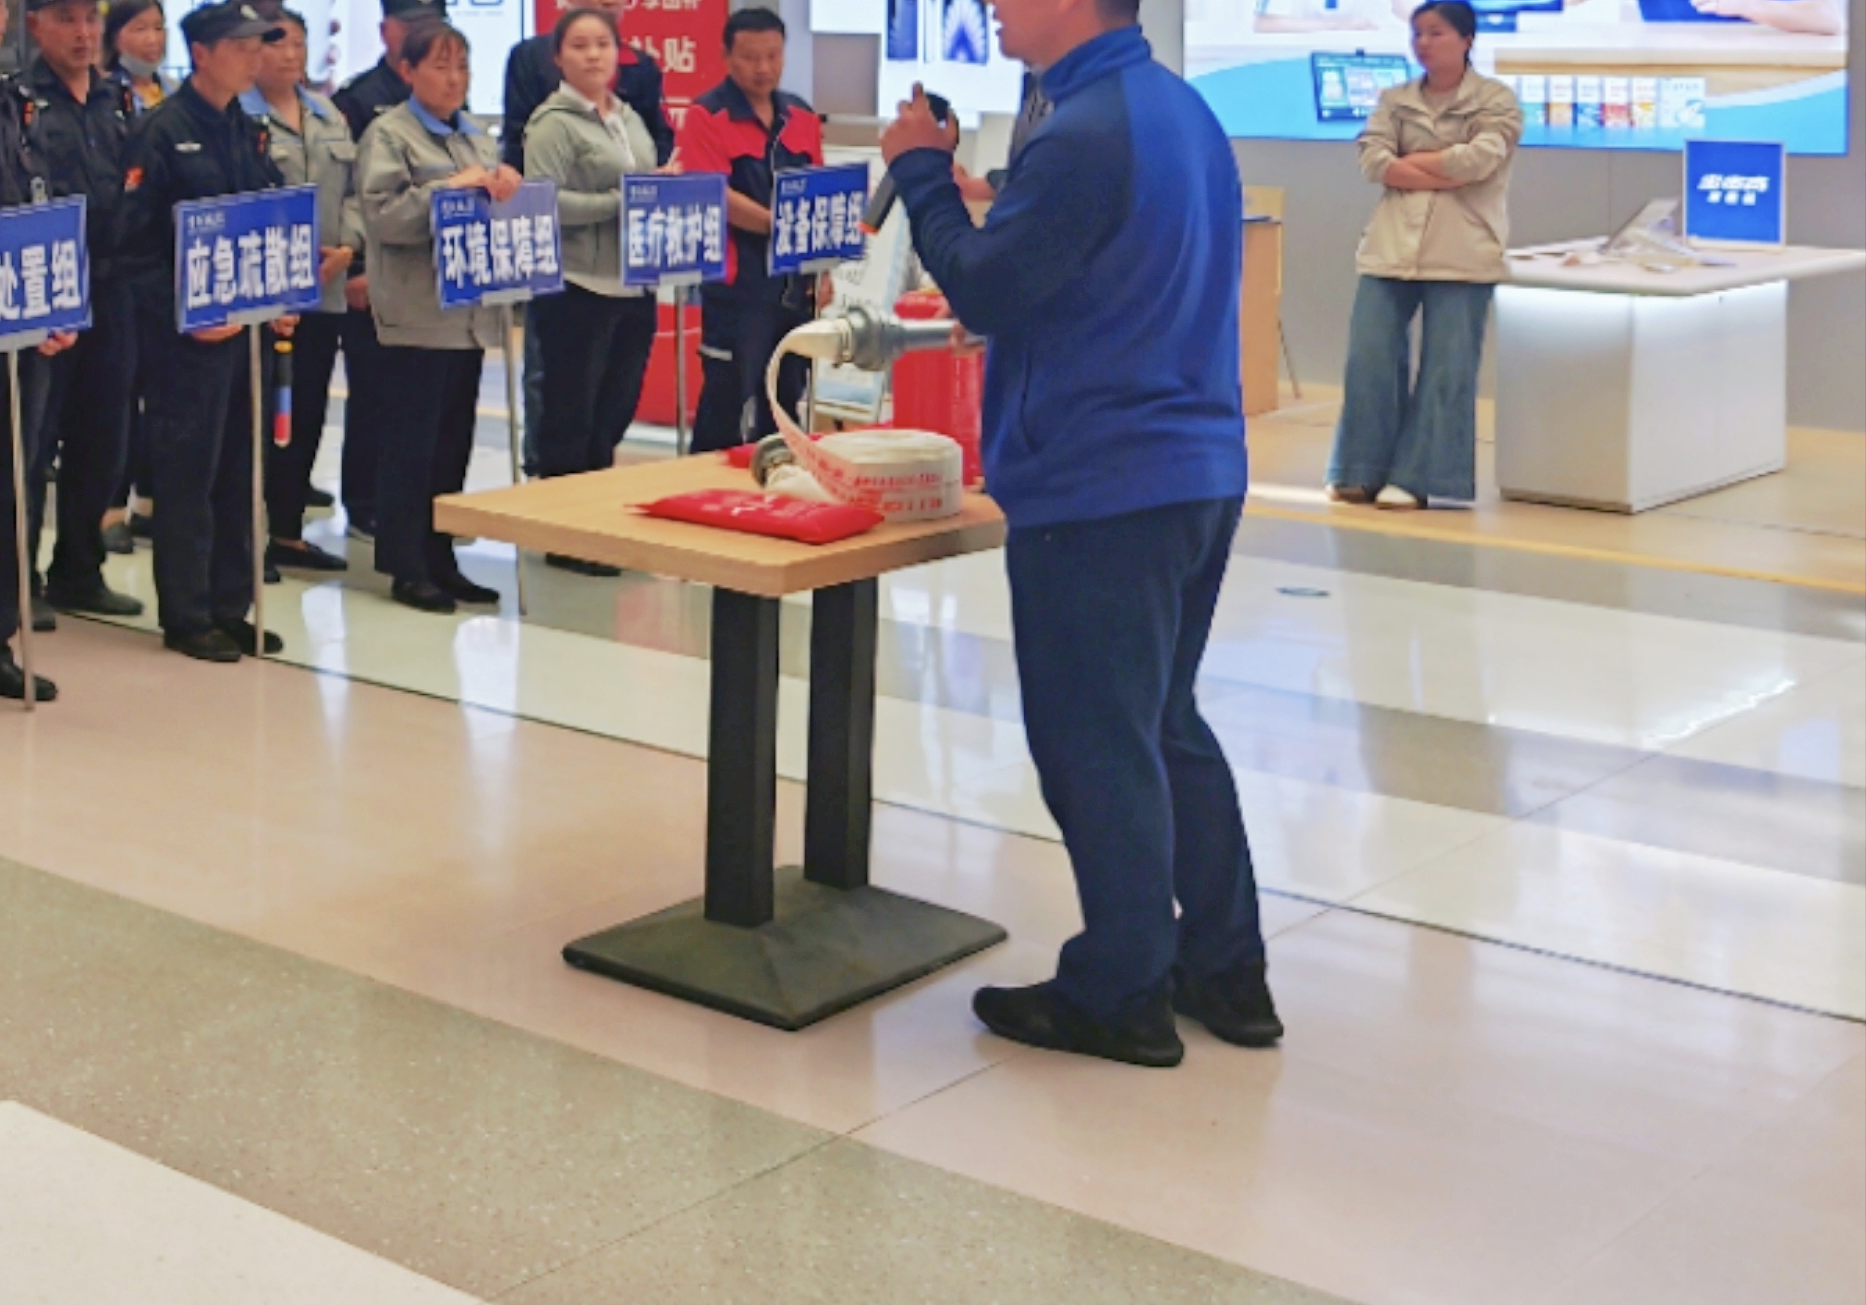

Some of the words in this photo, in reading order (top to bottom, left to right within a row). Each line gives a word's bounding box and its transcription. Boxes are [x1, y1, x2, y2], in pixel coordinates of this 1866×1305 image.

[442, 214, 559, 289] 环境保障组
[627, 204, 724, 268] 医疗救护组
[774, 190, 867, 258] 设备保障组
[187, 223, 315, 310] 应急疏散组
